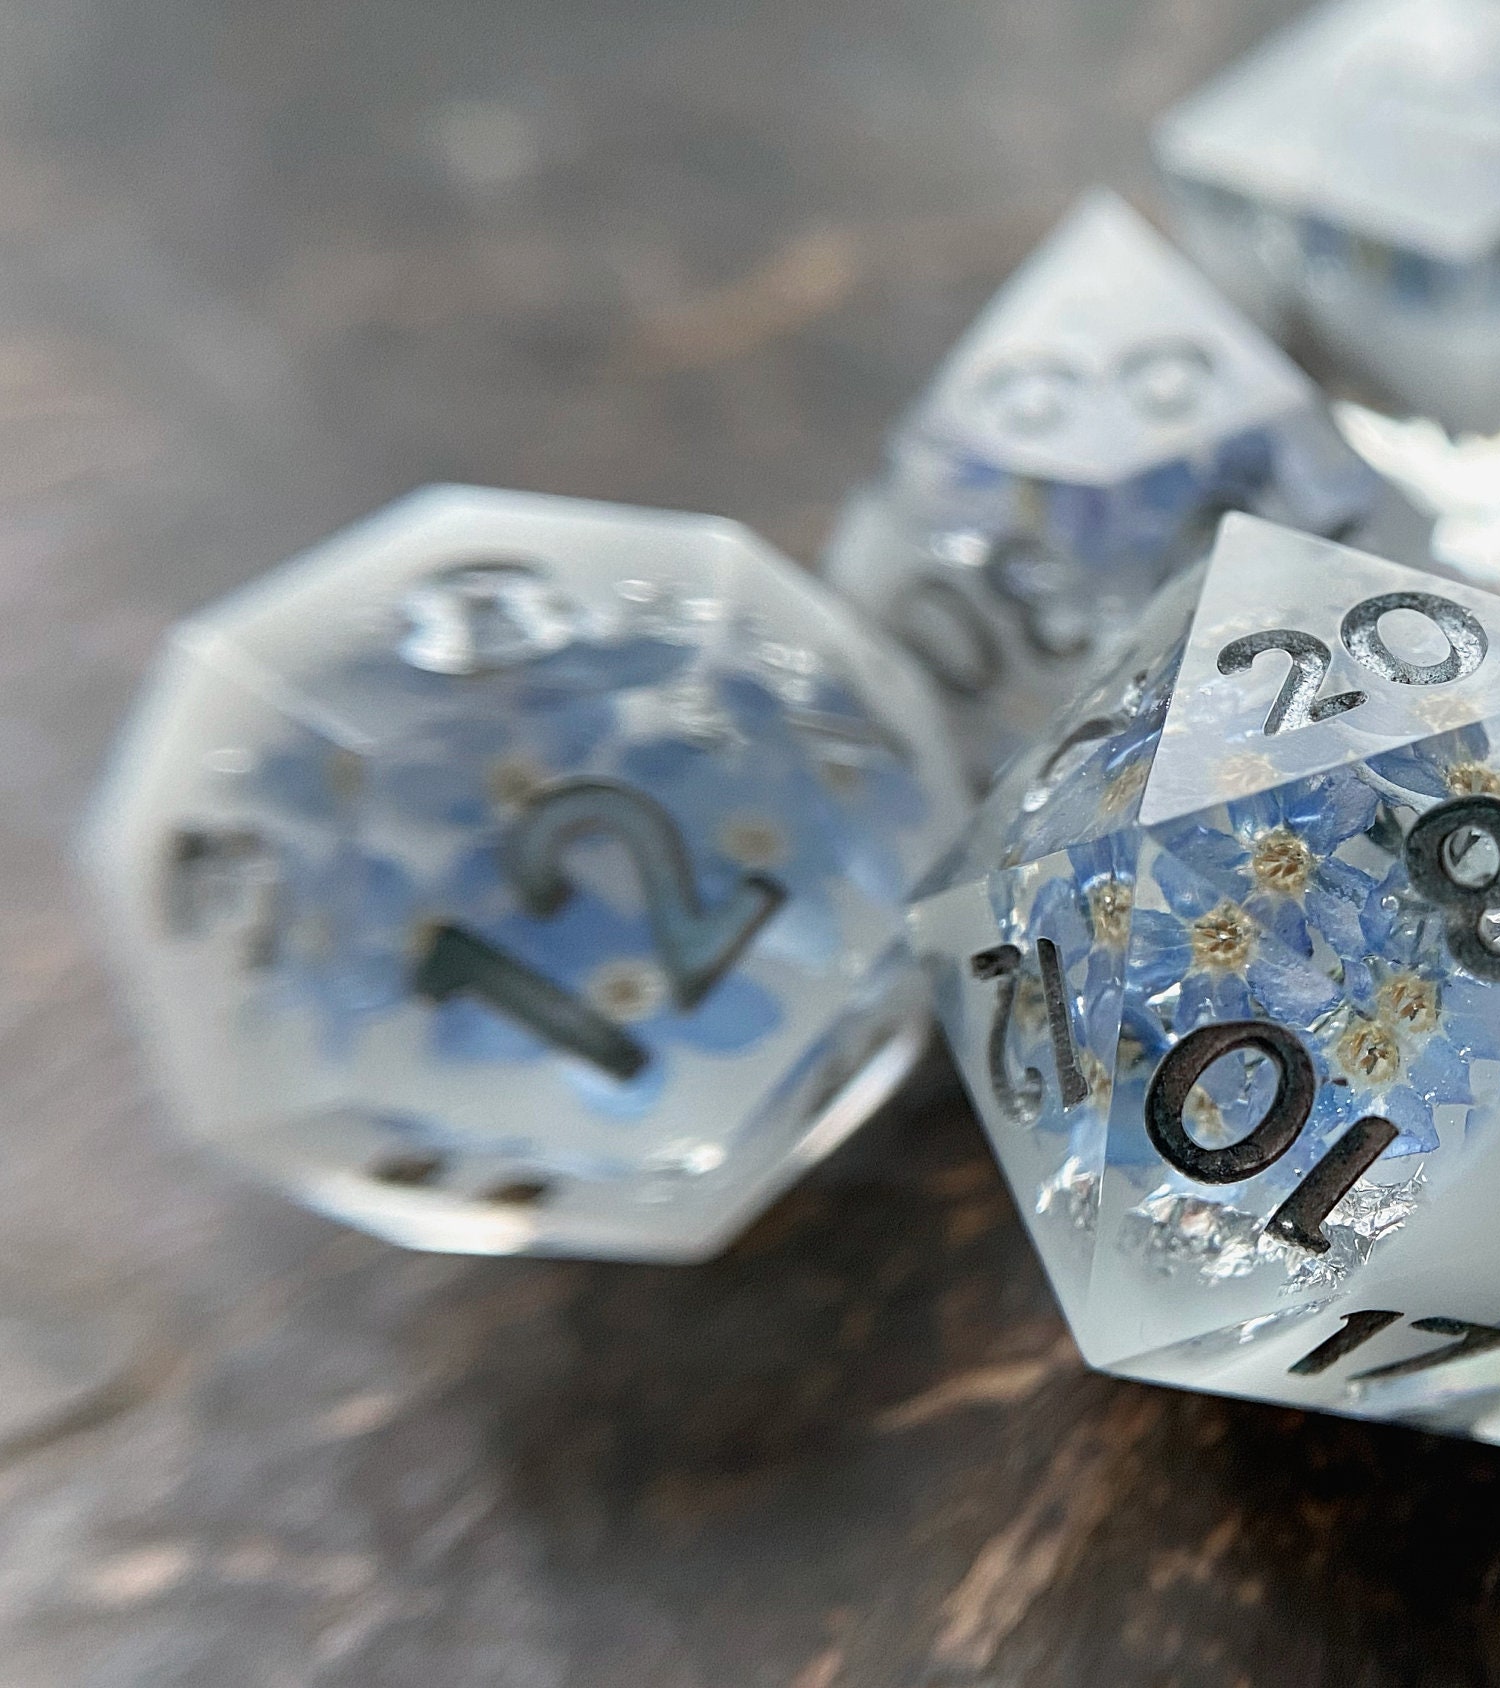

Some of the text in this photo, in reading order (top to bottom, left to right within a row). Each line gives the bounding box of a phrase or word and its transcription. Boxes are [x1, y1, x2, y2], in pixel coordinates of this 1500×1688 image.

[1217, 591, 1488, 736] 20
[415, 777, 787, 1082] 12
[1145, 1020, 1399, 1254] 10
